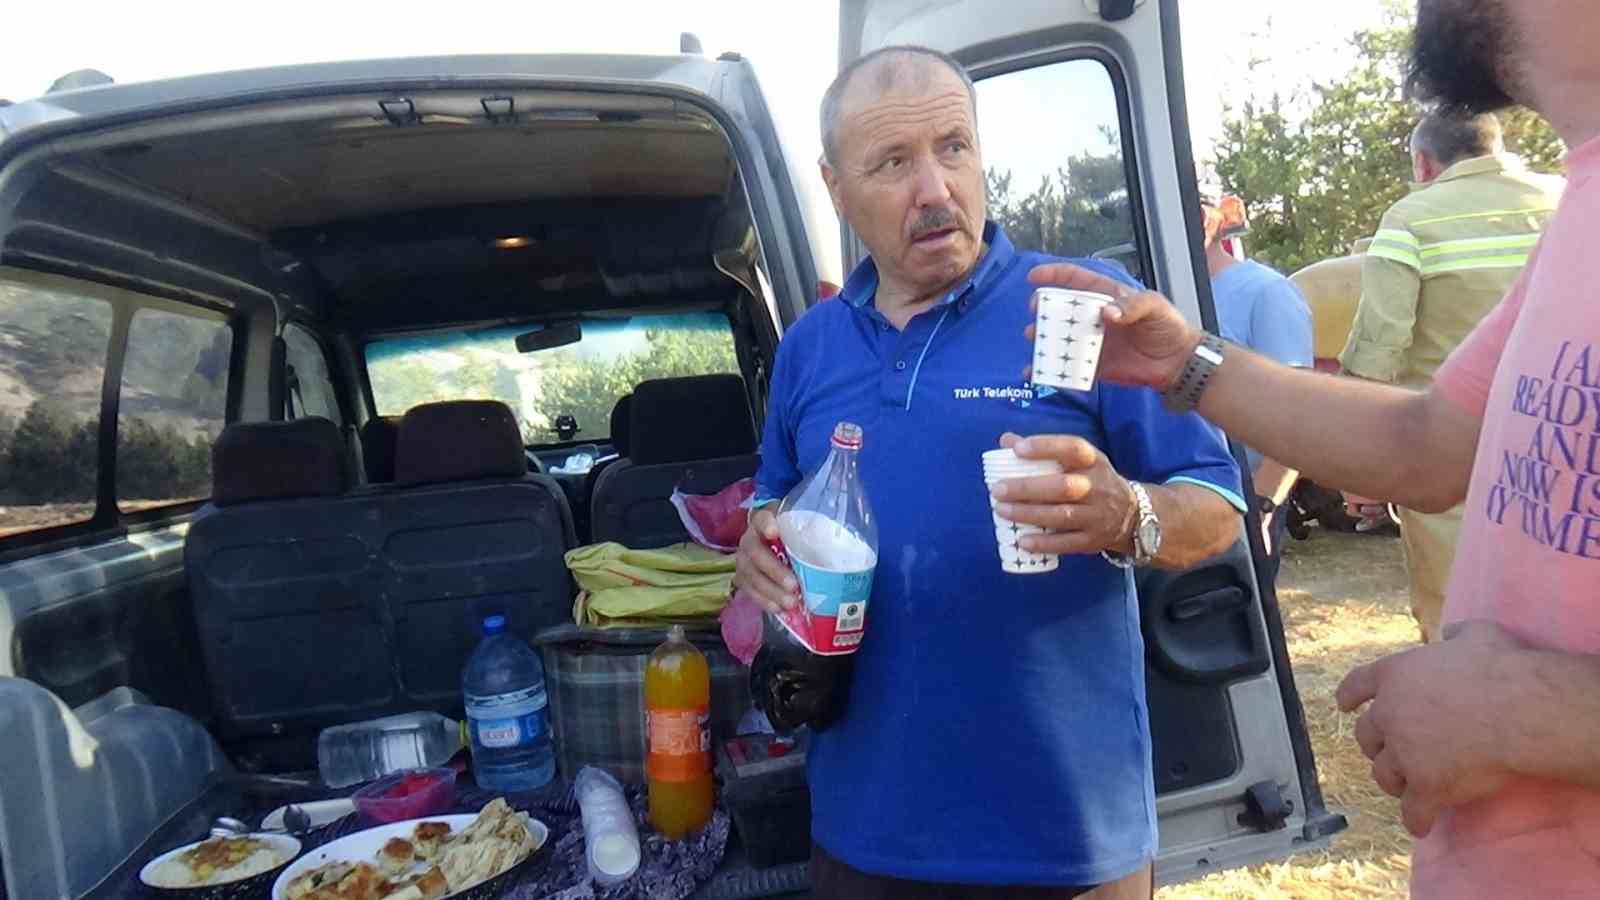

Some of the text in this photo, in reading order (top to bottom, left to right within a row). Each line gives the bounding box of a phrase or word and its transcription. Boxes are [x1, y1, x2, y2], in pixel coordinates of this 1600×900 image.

[1565, 344, 1600, 389] A
[982, 385, 1033, 399] Telekom
[1498, 449, 1560, 505] NOW
